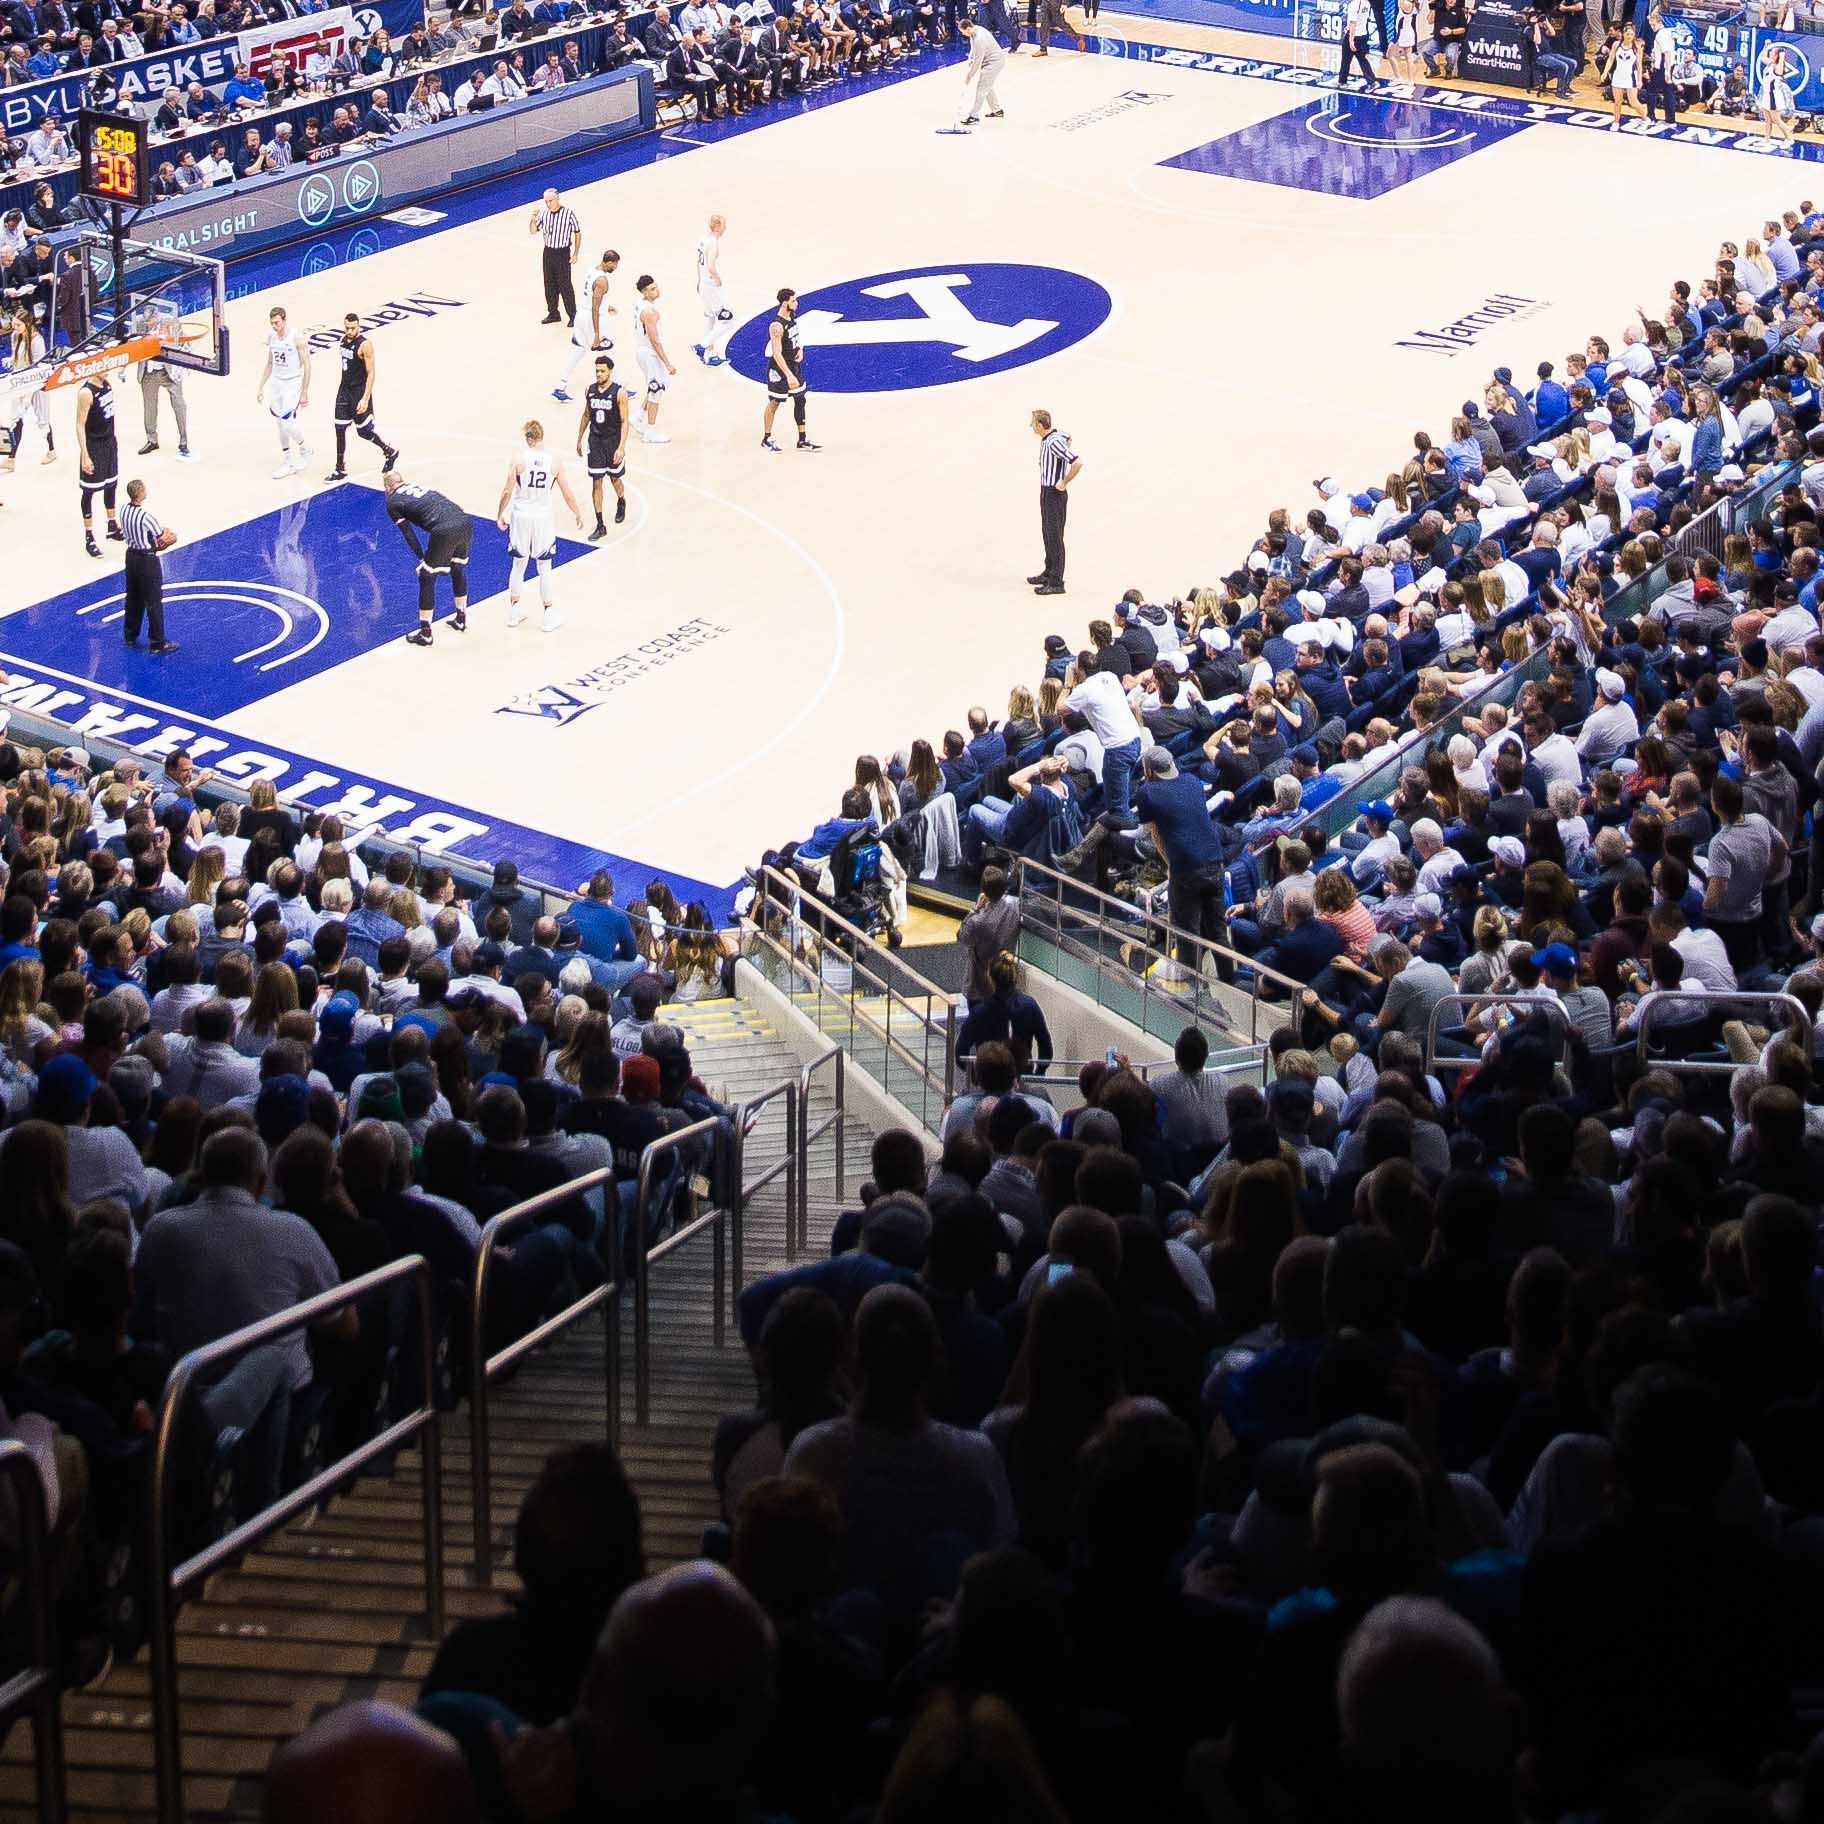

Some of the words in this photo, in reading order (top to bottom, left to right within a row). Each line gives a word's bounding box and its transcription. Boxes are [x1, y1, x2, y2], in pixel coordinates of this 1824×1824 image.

[1320, 13, 1343, 41] 39
[1704, 24, 1728, 54] 49
[96, 125, 136, 156] 15:08
[97, 154, 135, 197] 30
[308, 291, 473, 355] Marriot
[1391, 292, 1537, 358] Marriott
[273, 350, 287, 364] 24
[527, 471, 546, 490] 12
[565, 653, 641, 688] WEST
[637, 616, 714, 656] COAST
[596, 623, 731, 694] CONFERENCE
